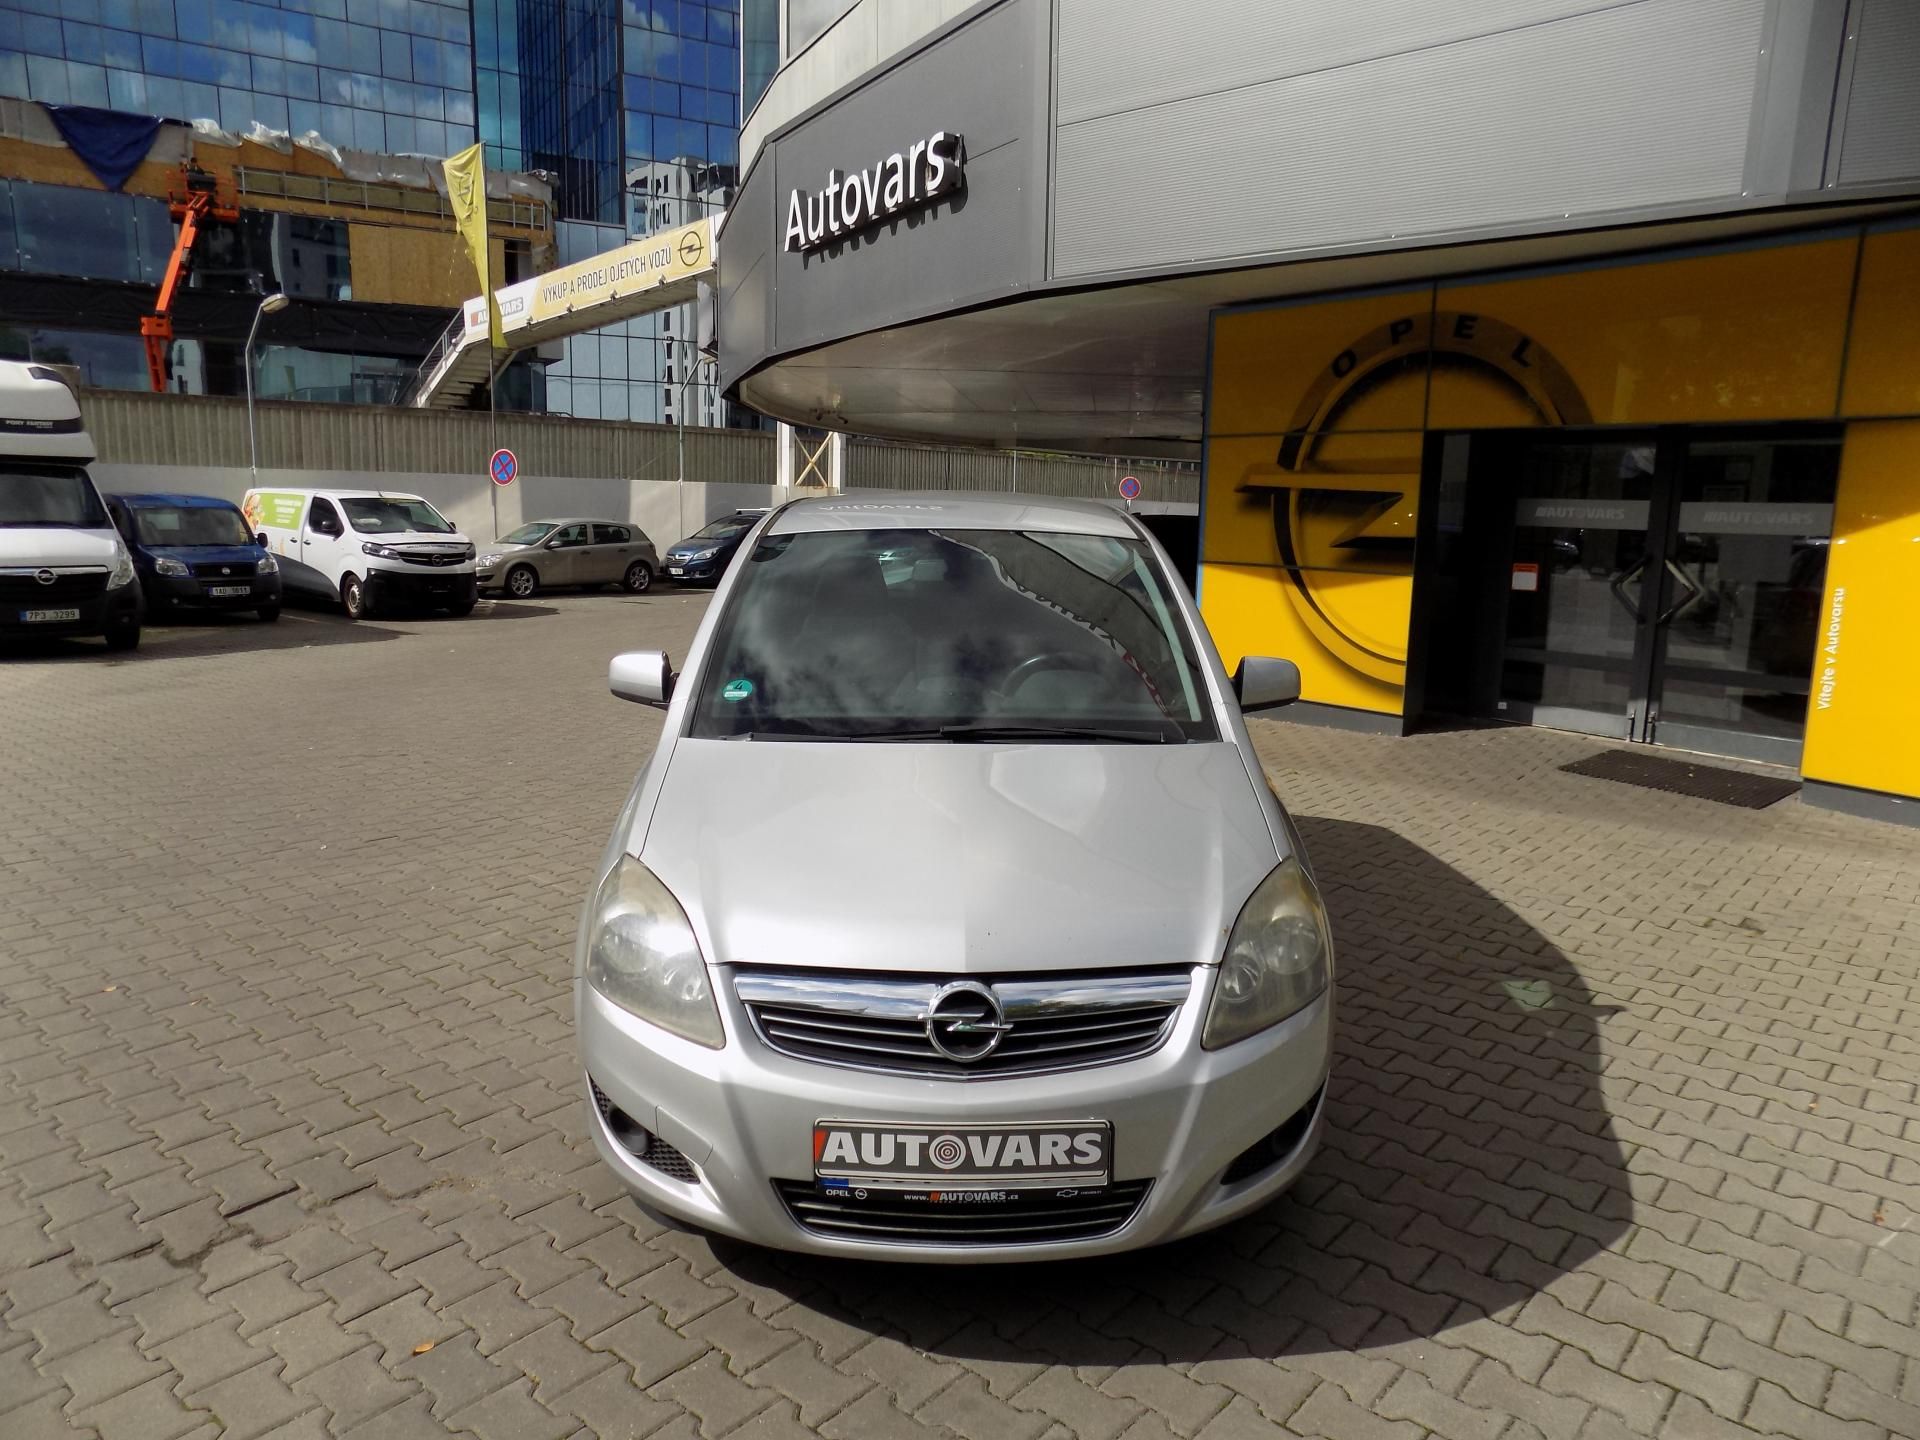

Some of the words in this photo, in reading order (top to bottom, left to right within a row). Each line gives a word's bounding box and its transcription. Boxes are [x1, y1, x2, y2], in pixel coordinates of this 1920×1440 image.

[784, 131, 945, 252] Autovars
[570, 280, 576, 295] A
[577, 269, 608, 293] PRODEJ
[610, 257, 647, 282] OJETÝCH
[1331, 314, 1532, 378] OPEL
[1543, 506, 1625, 520] AUTOVARS
[1712, 510, 1815, 525] AUTOVARS
[29, 612, 46, 620] 7P3
[53, 610, 76, 620] 3299
[1824, 587, 1845, 654] Autovarsu
[821, 1131, 1102, 1170] AUTOVARS
[825, 1188, 850, 1198] OPEL
